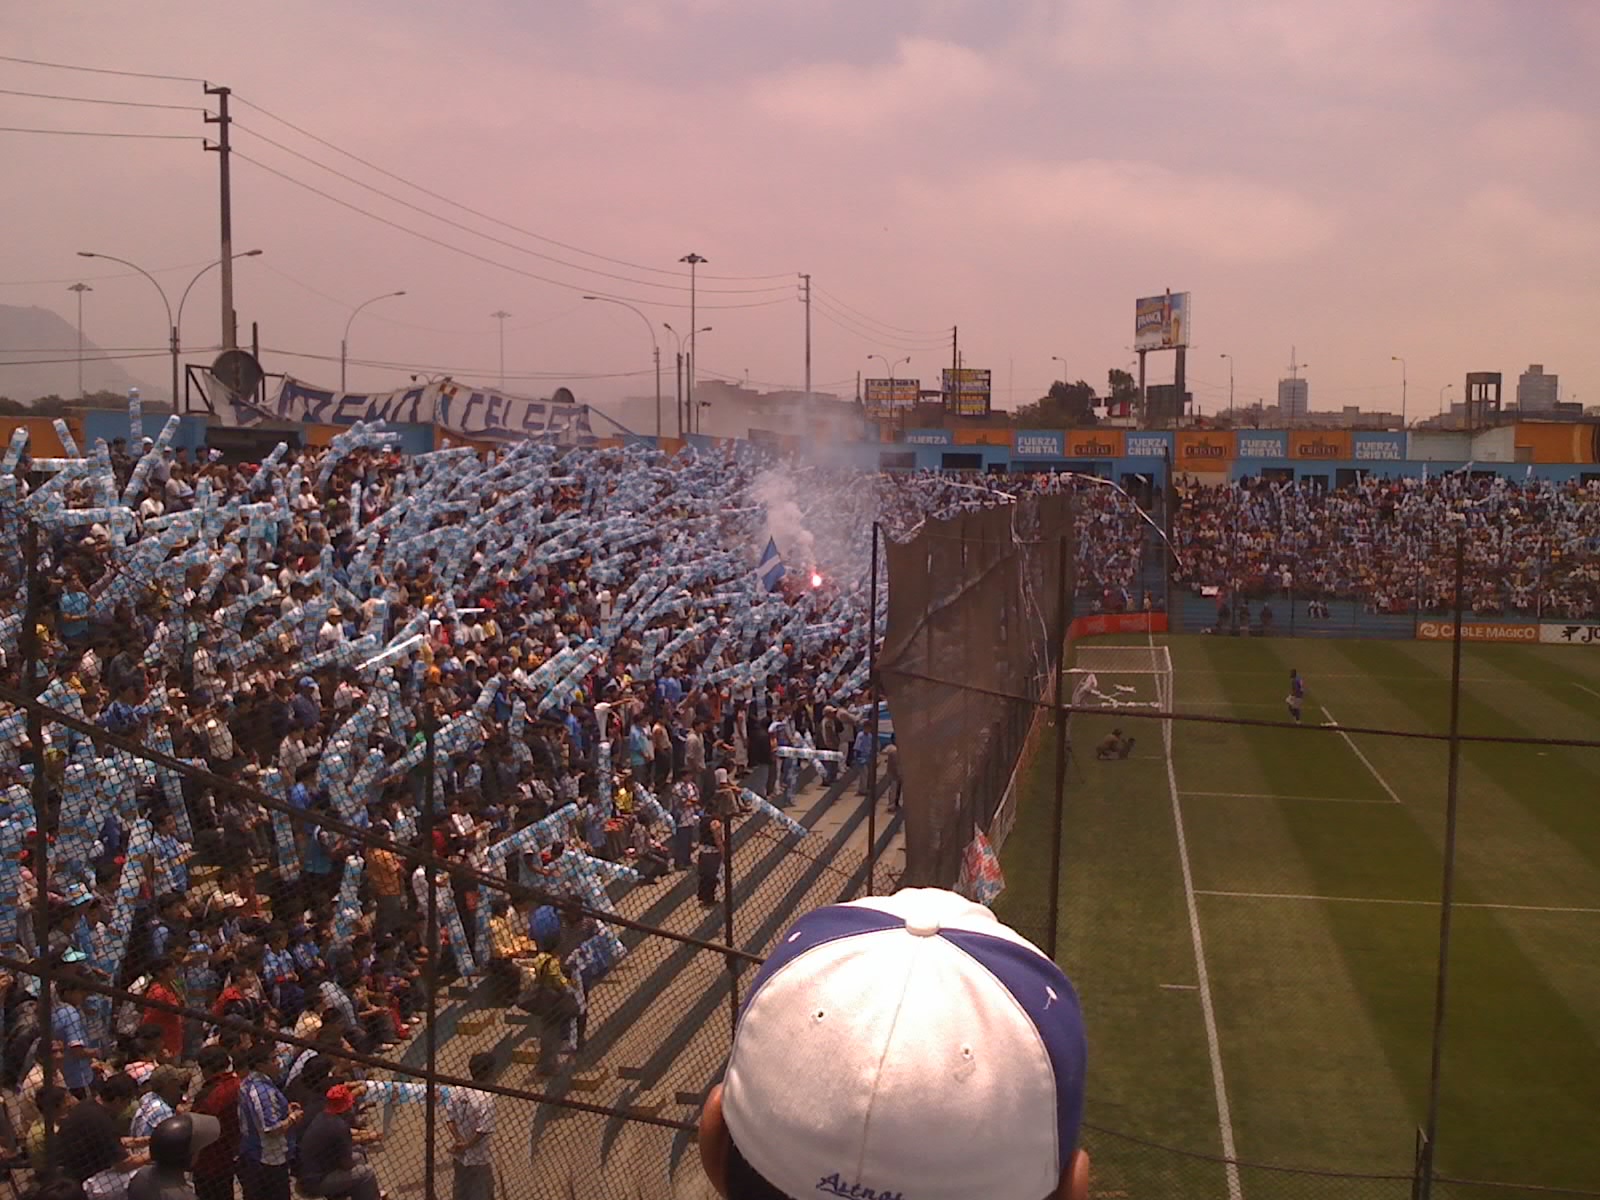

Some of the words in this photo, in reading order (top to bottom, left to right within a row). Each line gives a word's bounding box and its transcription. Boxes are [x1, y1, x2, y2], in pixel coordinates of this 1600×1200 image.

[906, 435, 948, 445] FUERZA
[1017, 436, 1058, 446] FUERZA
[1128, 438, 1168, 447] FUERZA
[1240, 439, 1281, 449] FUERZA
[1017, 445, 1059, 455] CRISTAL
[1356, 442, 1399, 451] FUERZA
[1240, 449, 1285, 458] CRISTAL
[1356, 450, 1401, 460] CRISTAL
